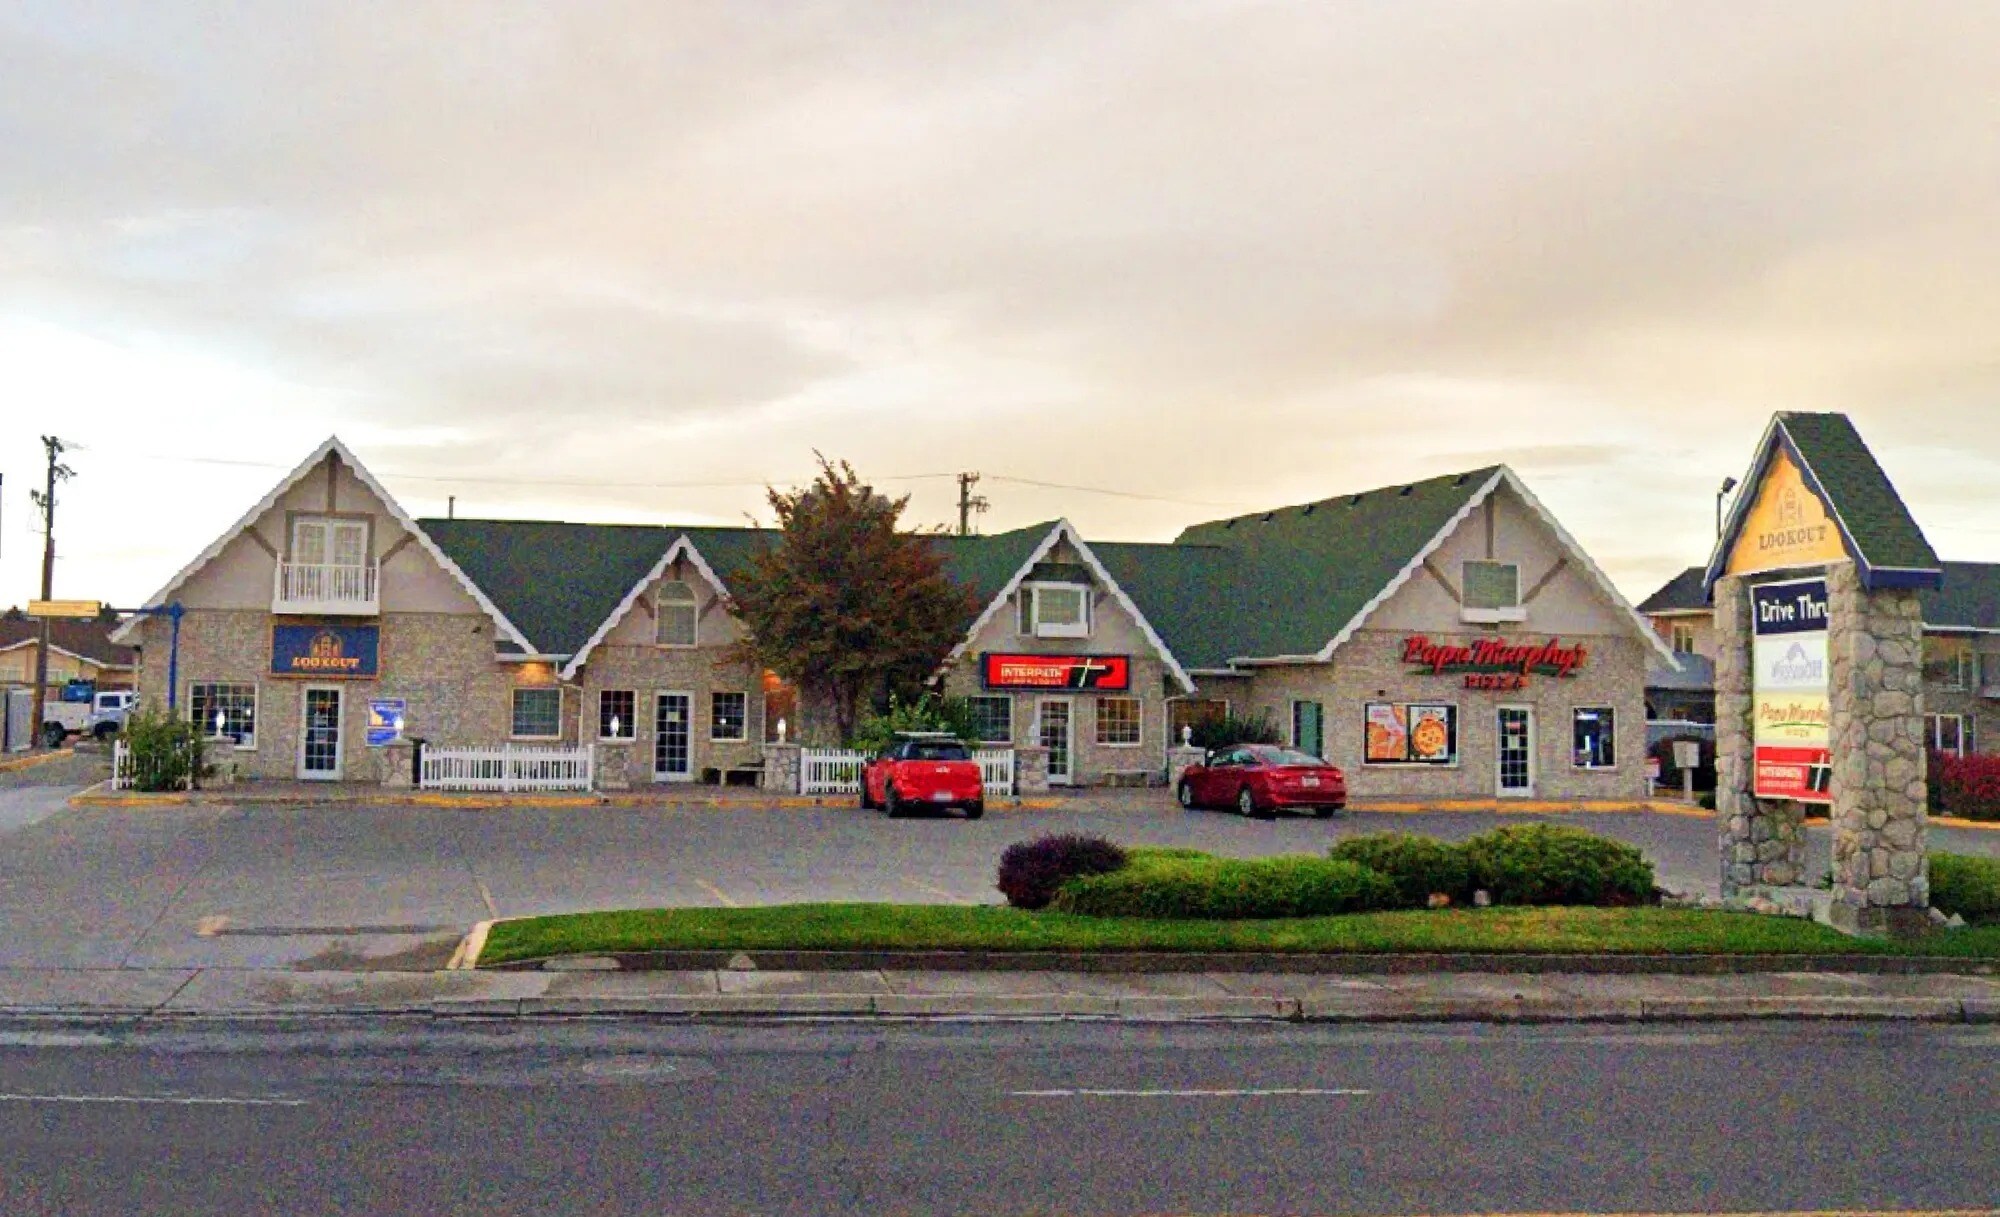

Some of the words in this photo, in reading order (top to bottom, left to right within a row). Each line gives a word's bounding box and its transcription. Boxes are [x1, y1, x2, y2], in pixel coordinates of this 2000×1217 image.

[1759, 525, 1826, 549] LOOKOUT
[1760, 598, 1795, 623] Drive
[292, 658, 358, 669] LOOKOUT
[1404, 636, 1472, 675] Papa
[1472, 637, 1586, 678] Murphy's
[1466, 675, 1529, 688] PIZZA
